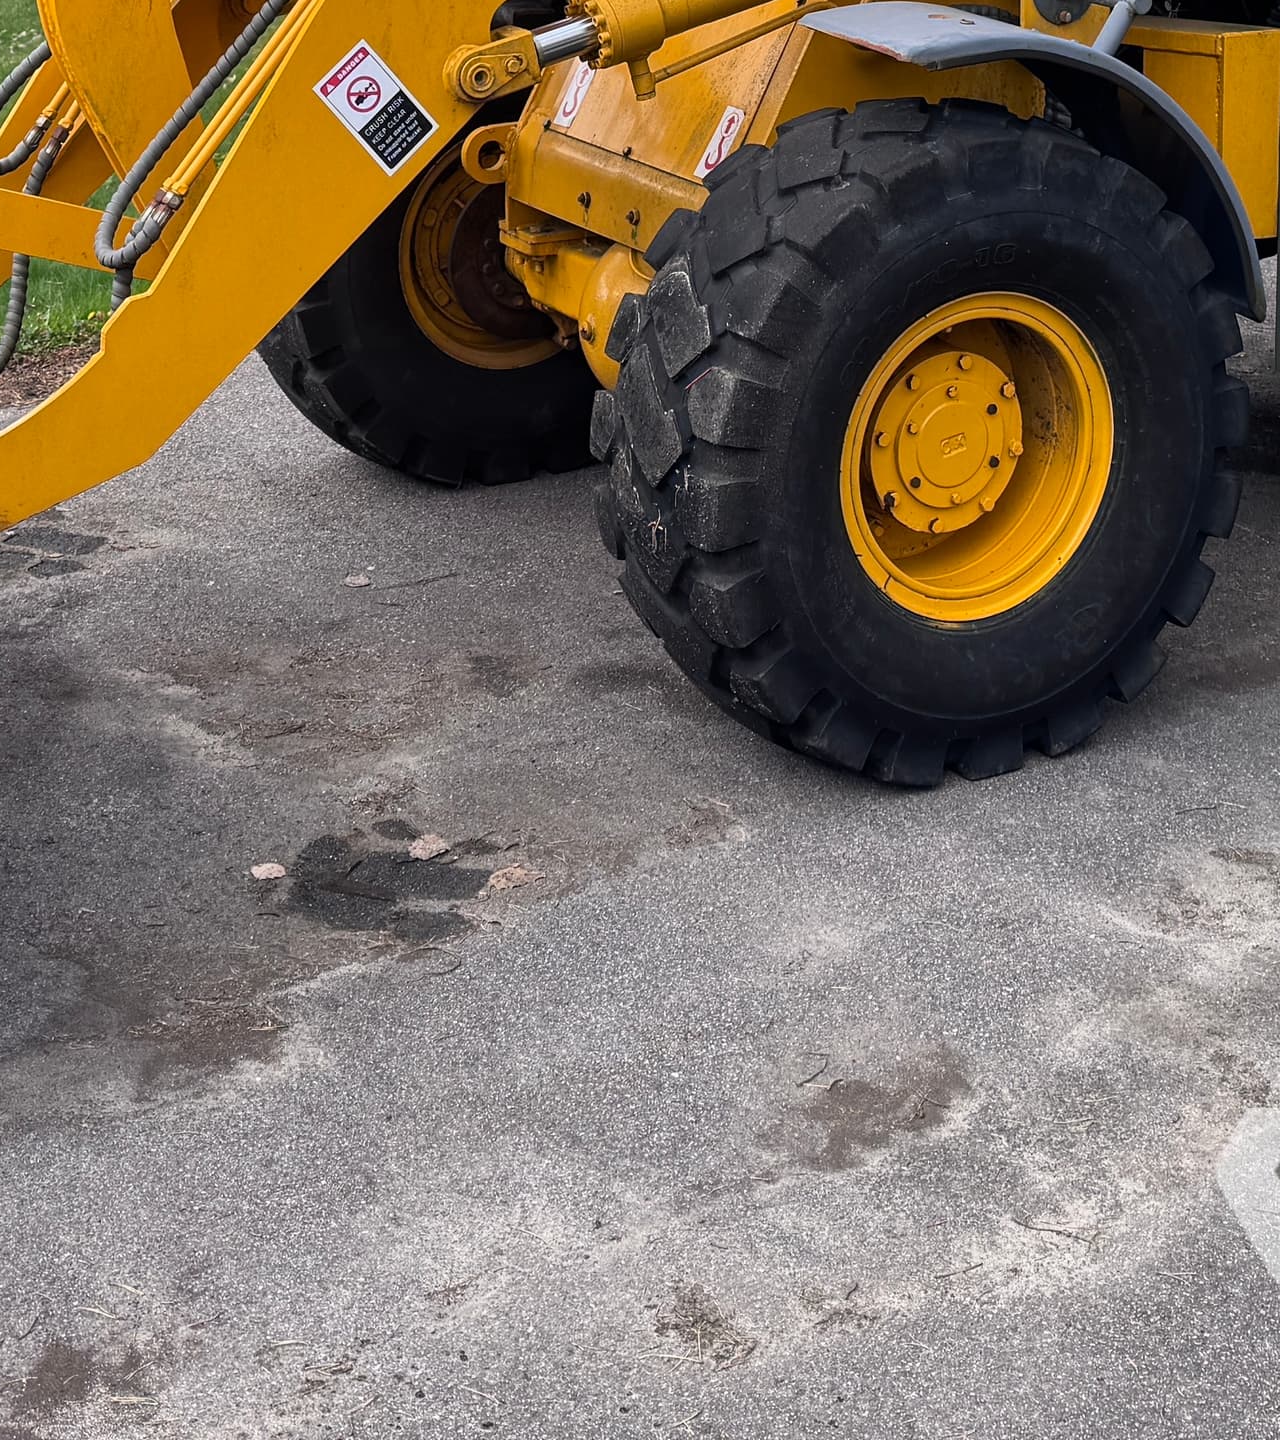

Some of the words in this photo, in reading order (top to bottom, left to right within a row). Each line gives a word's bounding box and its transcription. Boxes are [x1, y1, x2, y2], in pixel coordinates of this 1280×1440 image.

[336, 52, 365, 81] DANGER
[364, 112, 389, 137] CRUSH
[387, 95, 405, 114] RISK
[372, 127, 387, 145] KEEP
[387, 108, 407, 129] CLEAR
